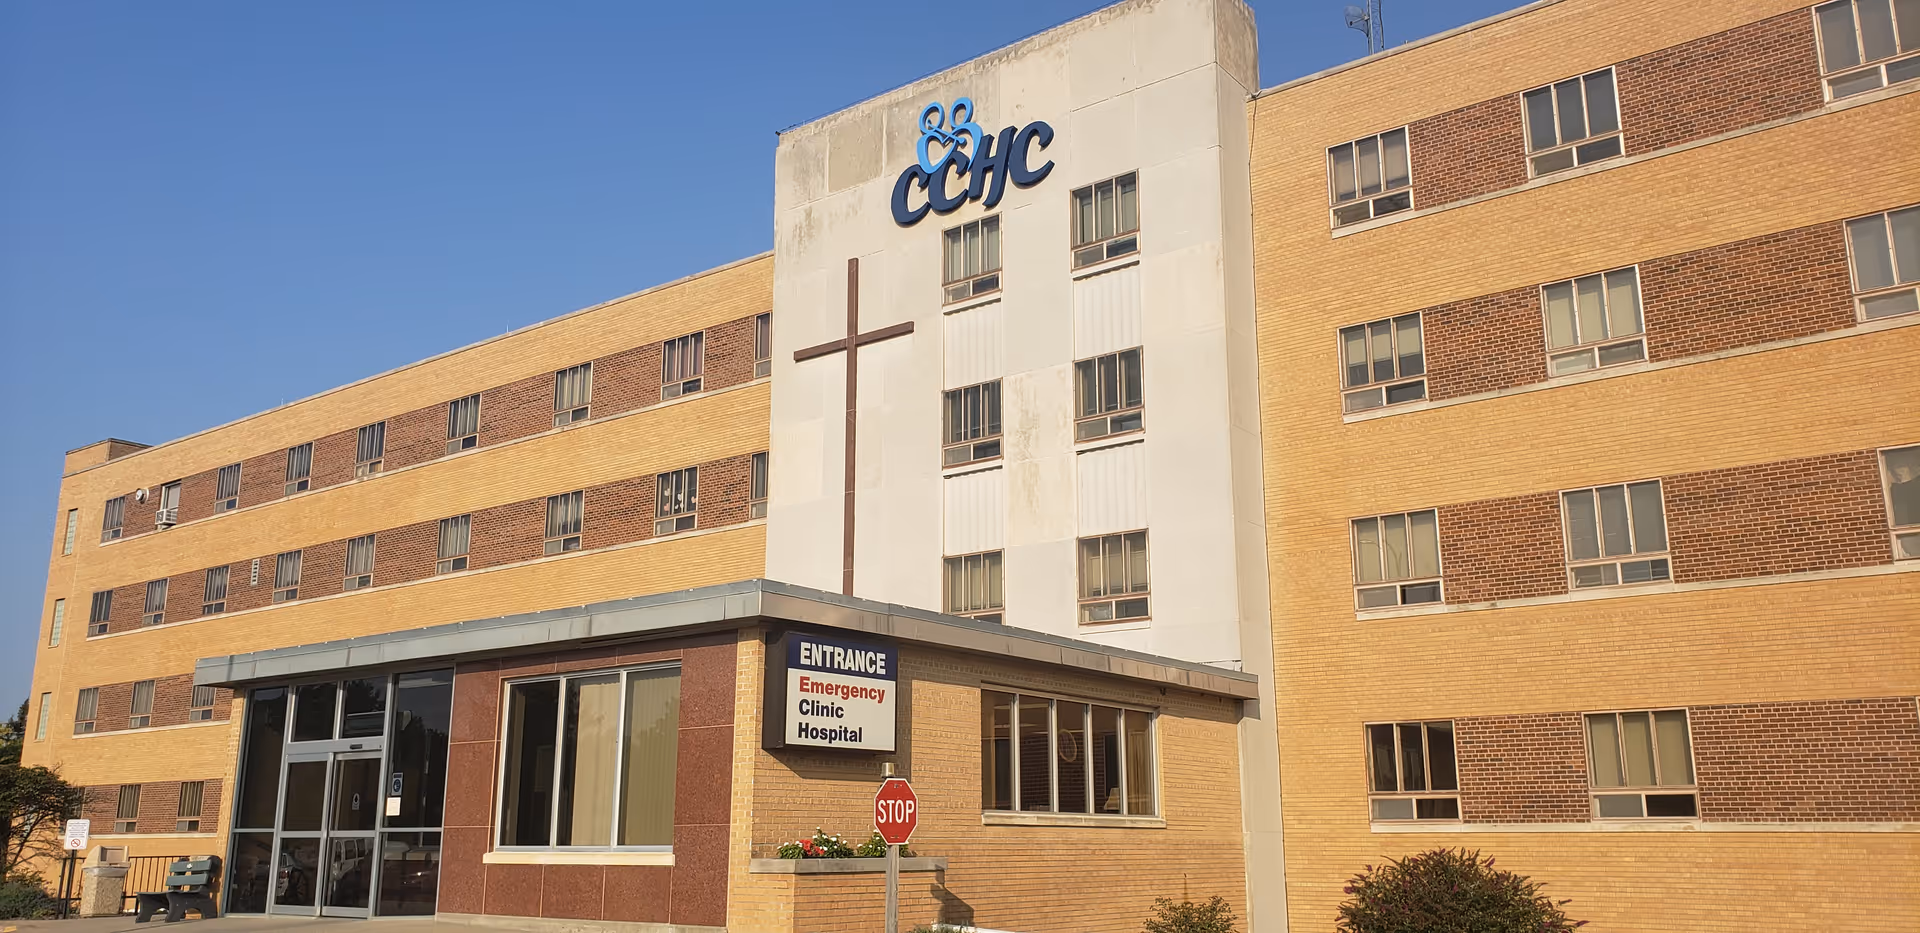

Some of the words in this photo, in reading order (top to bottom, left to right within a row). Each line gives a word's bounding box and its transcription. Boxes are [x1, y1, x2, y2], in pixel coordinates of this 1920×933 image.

[891, 121, 1055, 225] CCHC
[800, 641, 886, 674] ENTRANCE
[799, 676, 885, 703] Emergency
[798, 699, 844, 718] Clinic
[798, 722, 862, 743] Hospital
[877, 800, 914, 823] STOP
